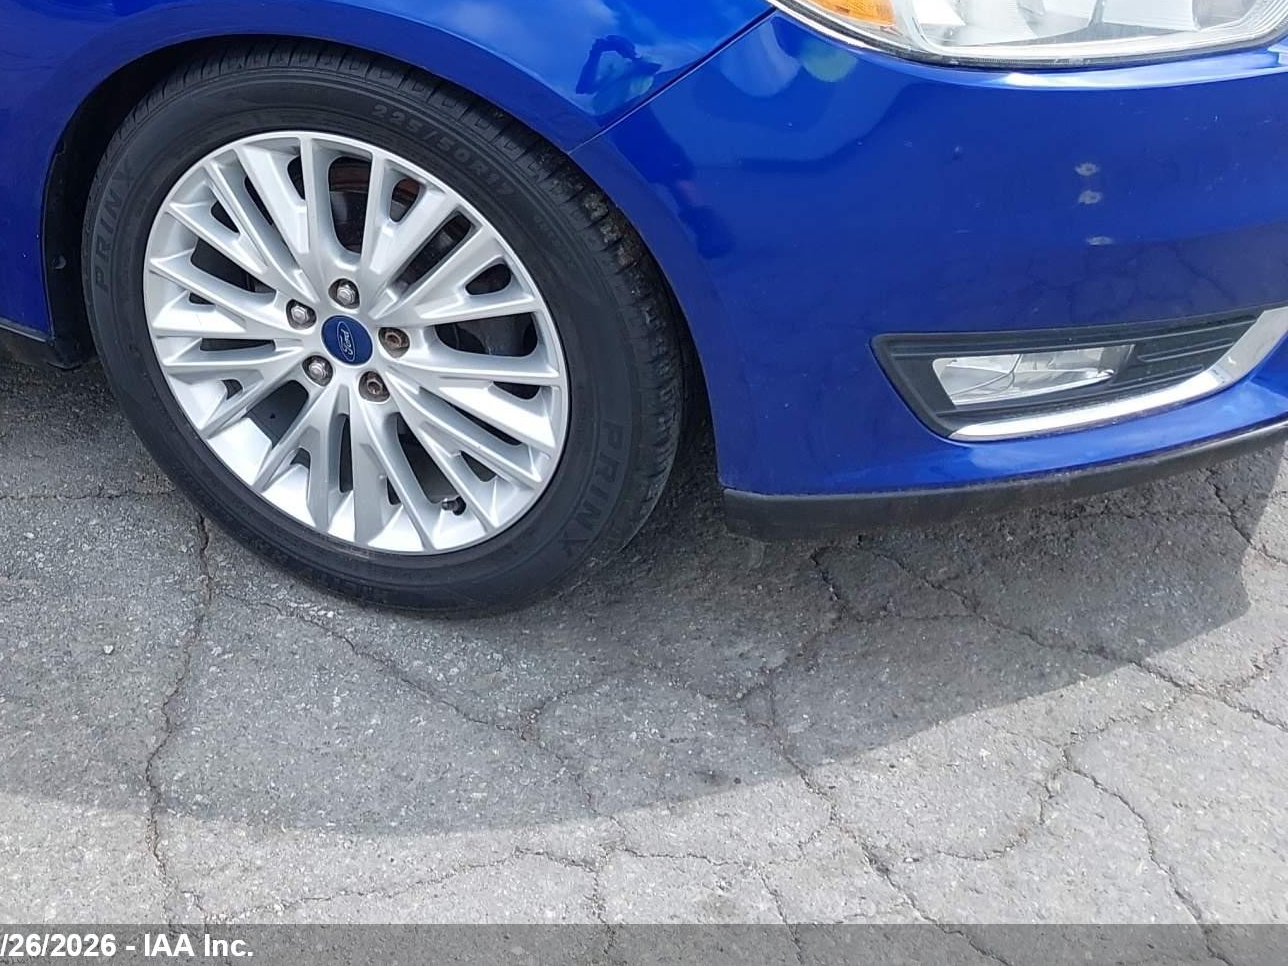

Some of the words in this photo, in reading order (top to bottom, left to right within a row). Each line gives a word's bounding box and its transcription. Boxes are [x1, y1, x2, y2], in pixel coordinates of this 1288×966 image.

[95, 163, 134, 294] PRINX
[339, 326, 355, 358] Ford
[558, 419, 626, 557] PRINX
